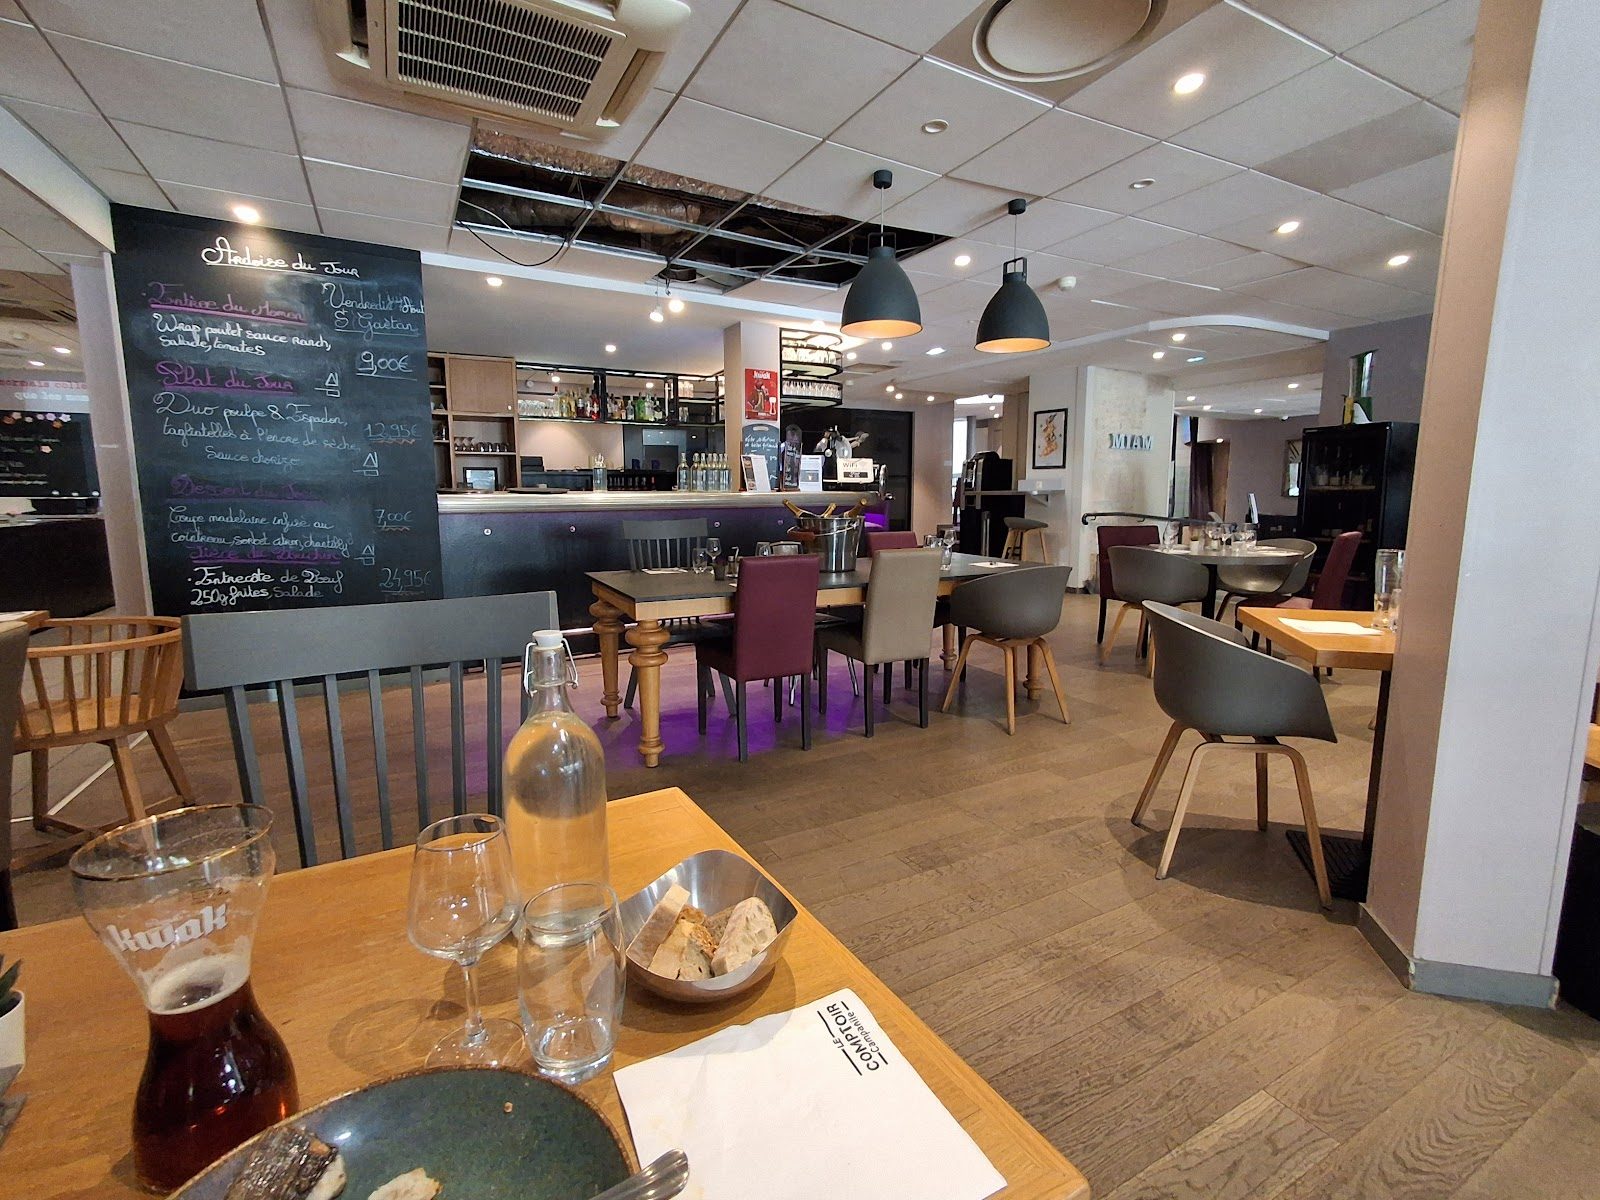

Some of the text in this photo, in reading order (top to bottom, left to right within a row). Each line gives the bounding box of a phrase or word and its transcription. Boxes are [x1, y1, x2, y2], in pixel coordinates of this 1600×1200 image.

[201, 237, 360, 278] Ardoise du Jour
[222, 293, 248, 312] du
[205, 321, 243, 342] poulet
[153, 391, 219, 415] Duo
[1109, 433, 1153, 451] MIAM
[313, 520, 334, 530] au
[280, 569, 300, 583] de
[106, 903, 229, 952] kwak
[826, 1003, 880, 1071] COMPTOIR
[832, 1037, 845, 1049] LE
